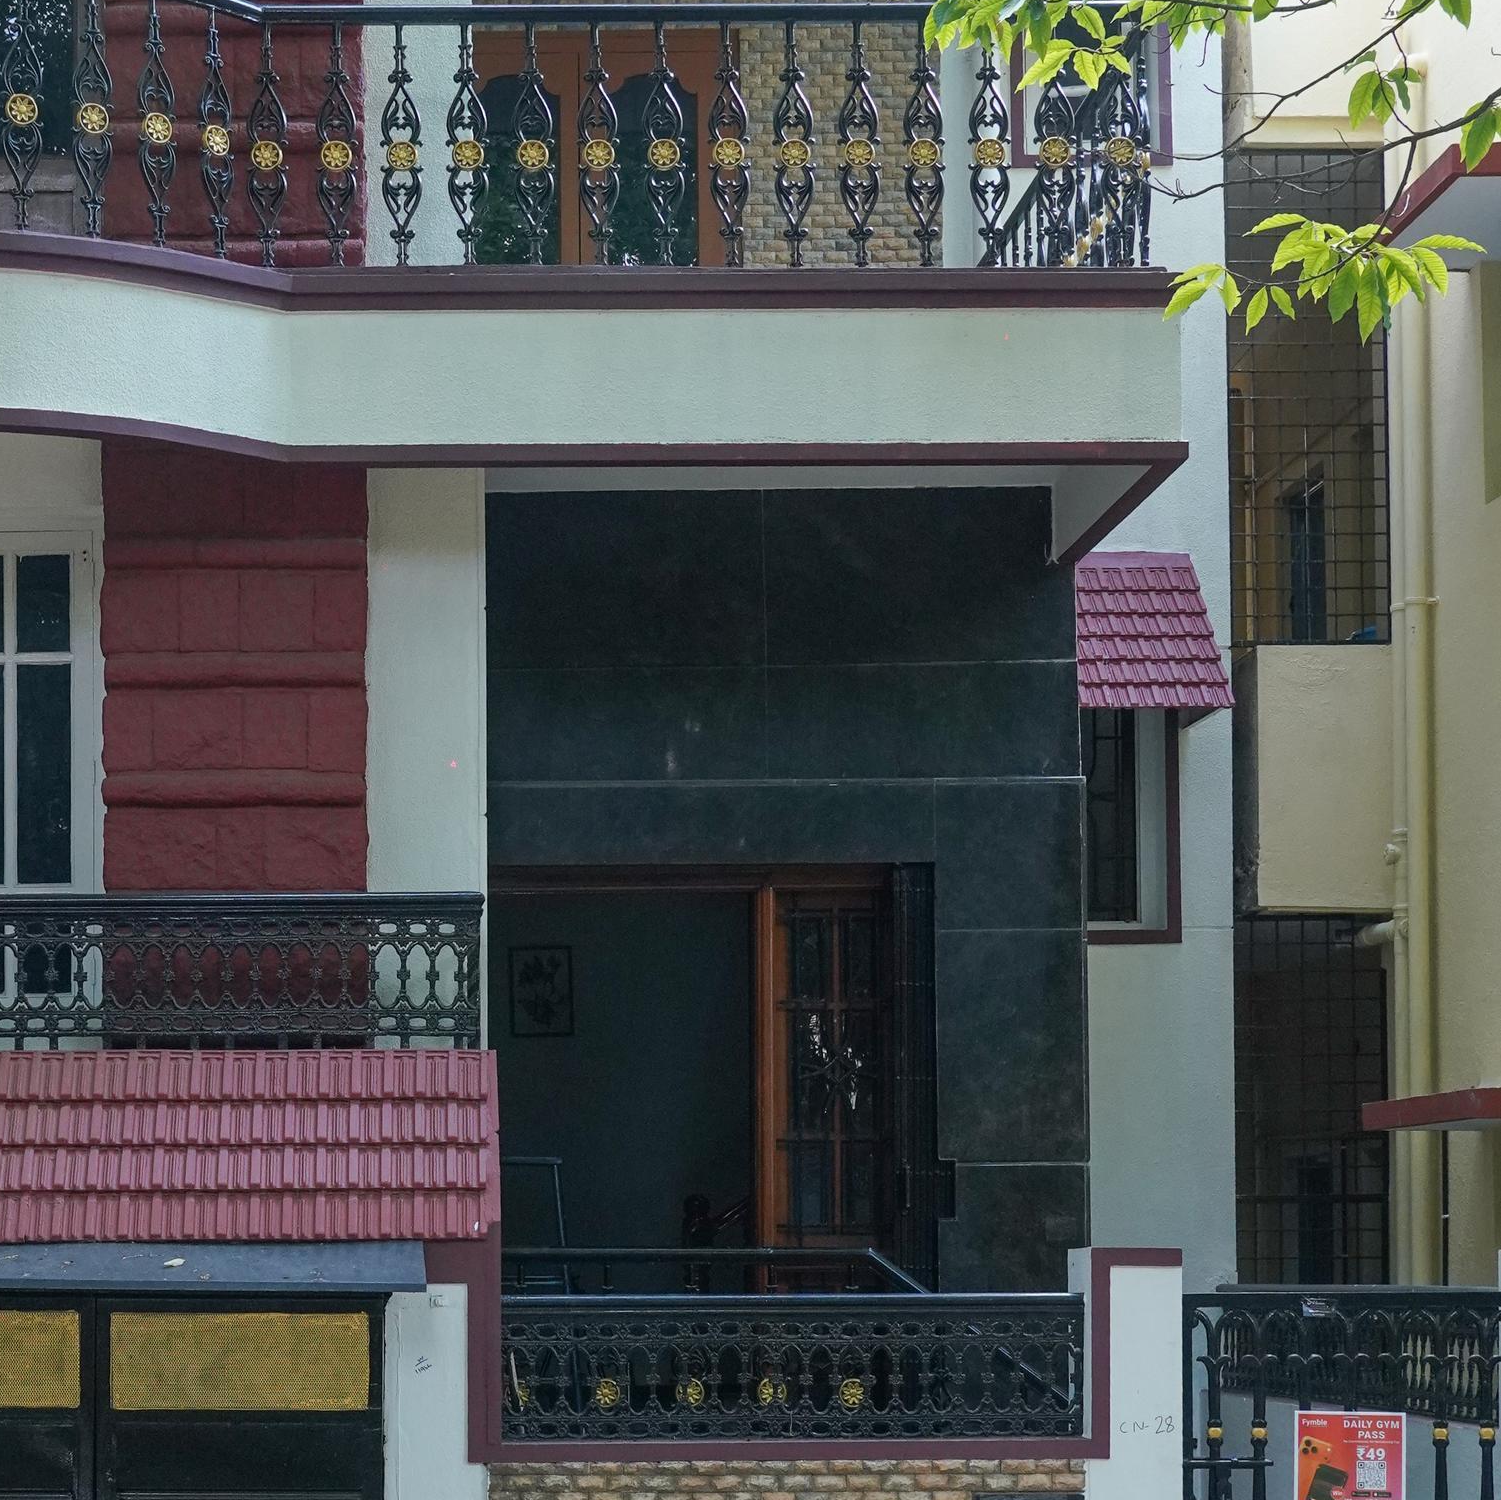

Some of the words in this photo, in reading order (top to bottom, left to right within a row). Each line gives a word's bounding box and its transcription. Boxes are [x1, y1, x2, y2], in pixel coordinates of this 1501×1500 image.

[1302, 1418, 1328, 1426] Fymble
[1343, 1420, 1373, 1429] DAILY
[1376, 1420, 1400, 1429] GYM
[1357, 1431, 1386, 1439] PASS
[1356, 1447, 1386, 1461] ₹49
